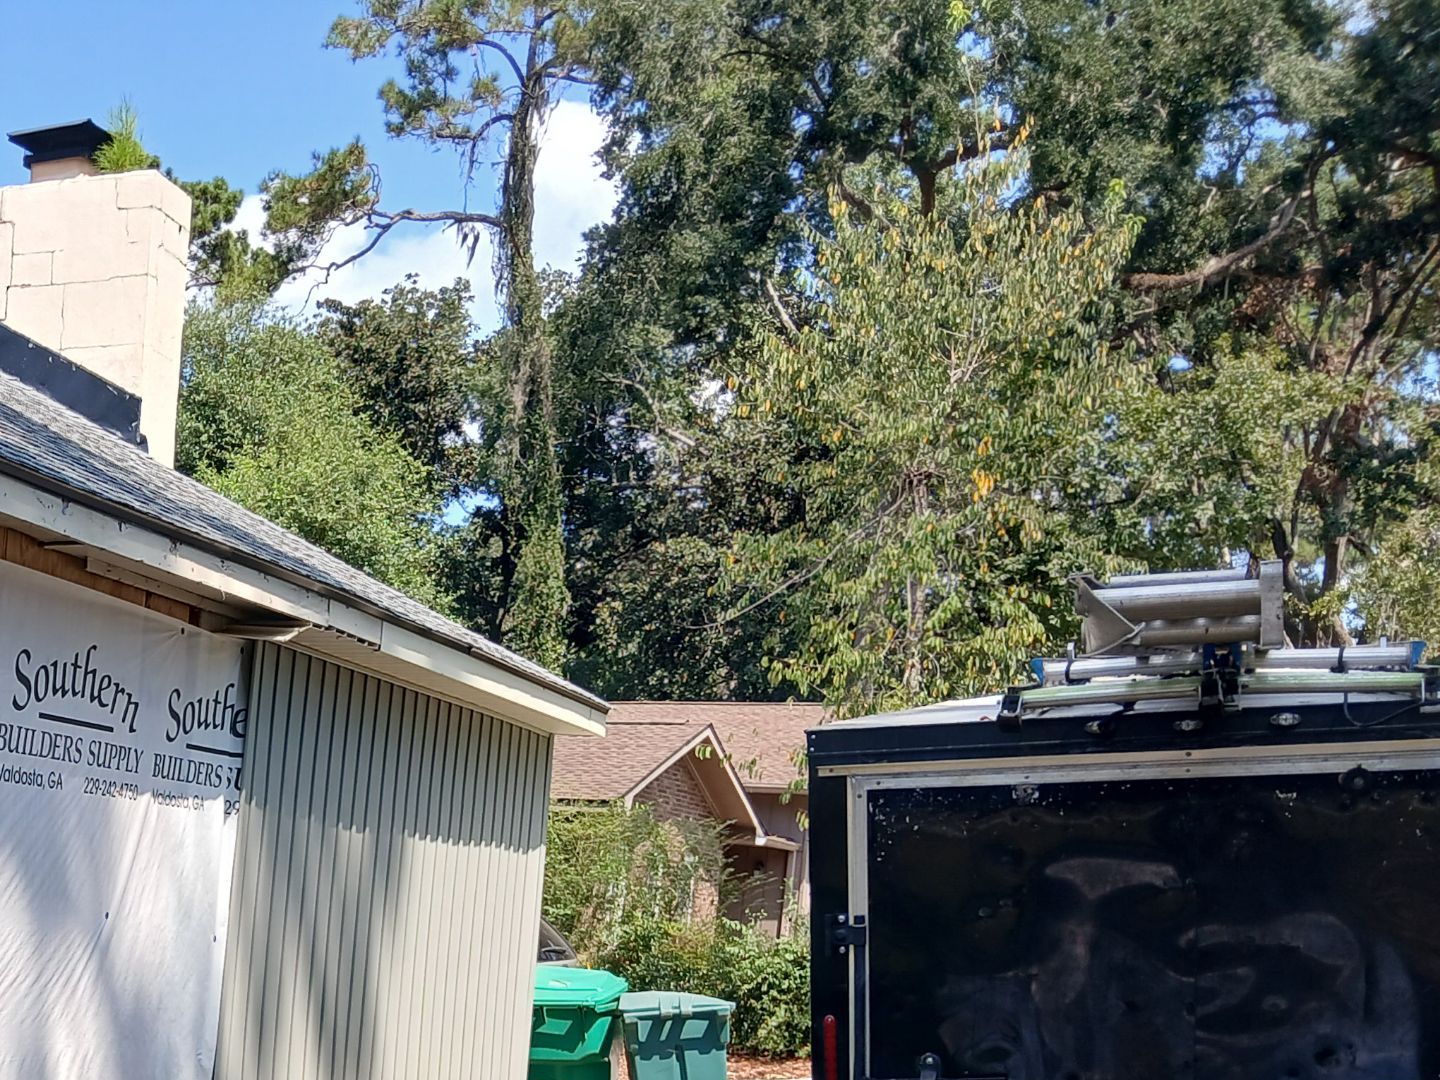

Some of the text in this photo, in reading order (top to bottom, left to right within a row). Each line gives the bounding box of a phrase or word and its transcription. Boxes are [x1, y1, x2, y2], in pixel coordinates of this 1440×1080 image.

[12, 644, 140, 734] Southern
[86, 740, 144, 775] SUPPLY
[152, 753, 224, 788] BUILDERS
[47, 771, 64, 791] GA
[83, 777, 139, 801] 229-242-4750
[192, 794, 205, 812] GA
